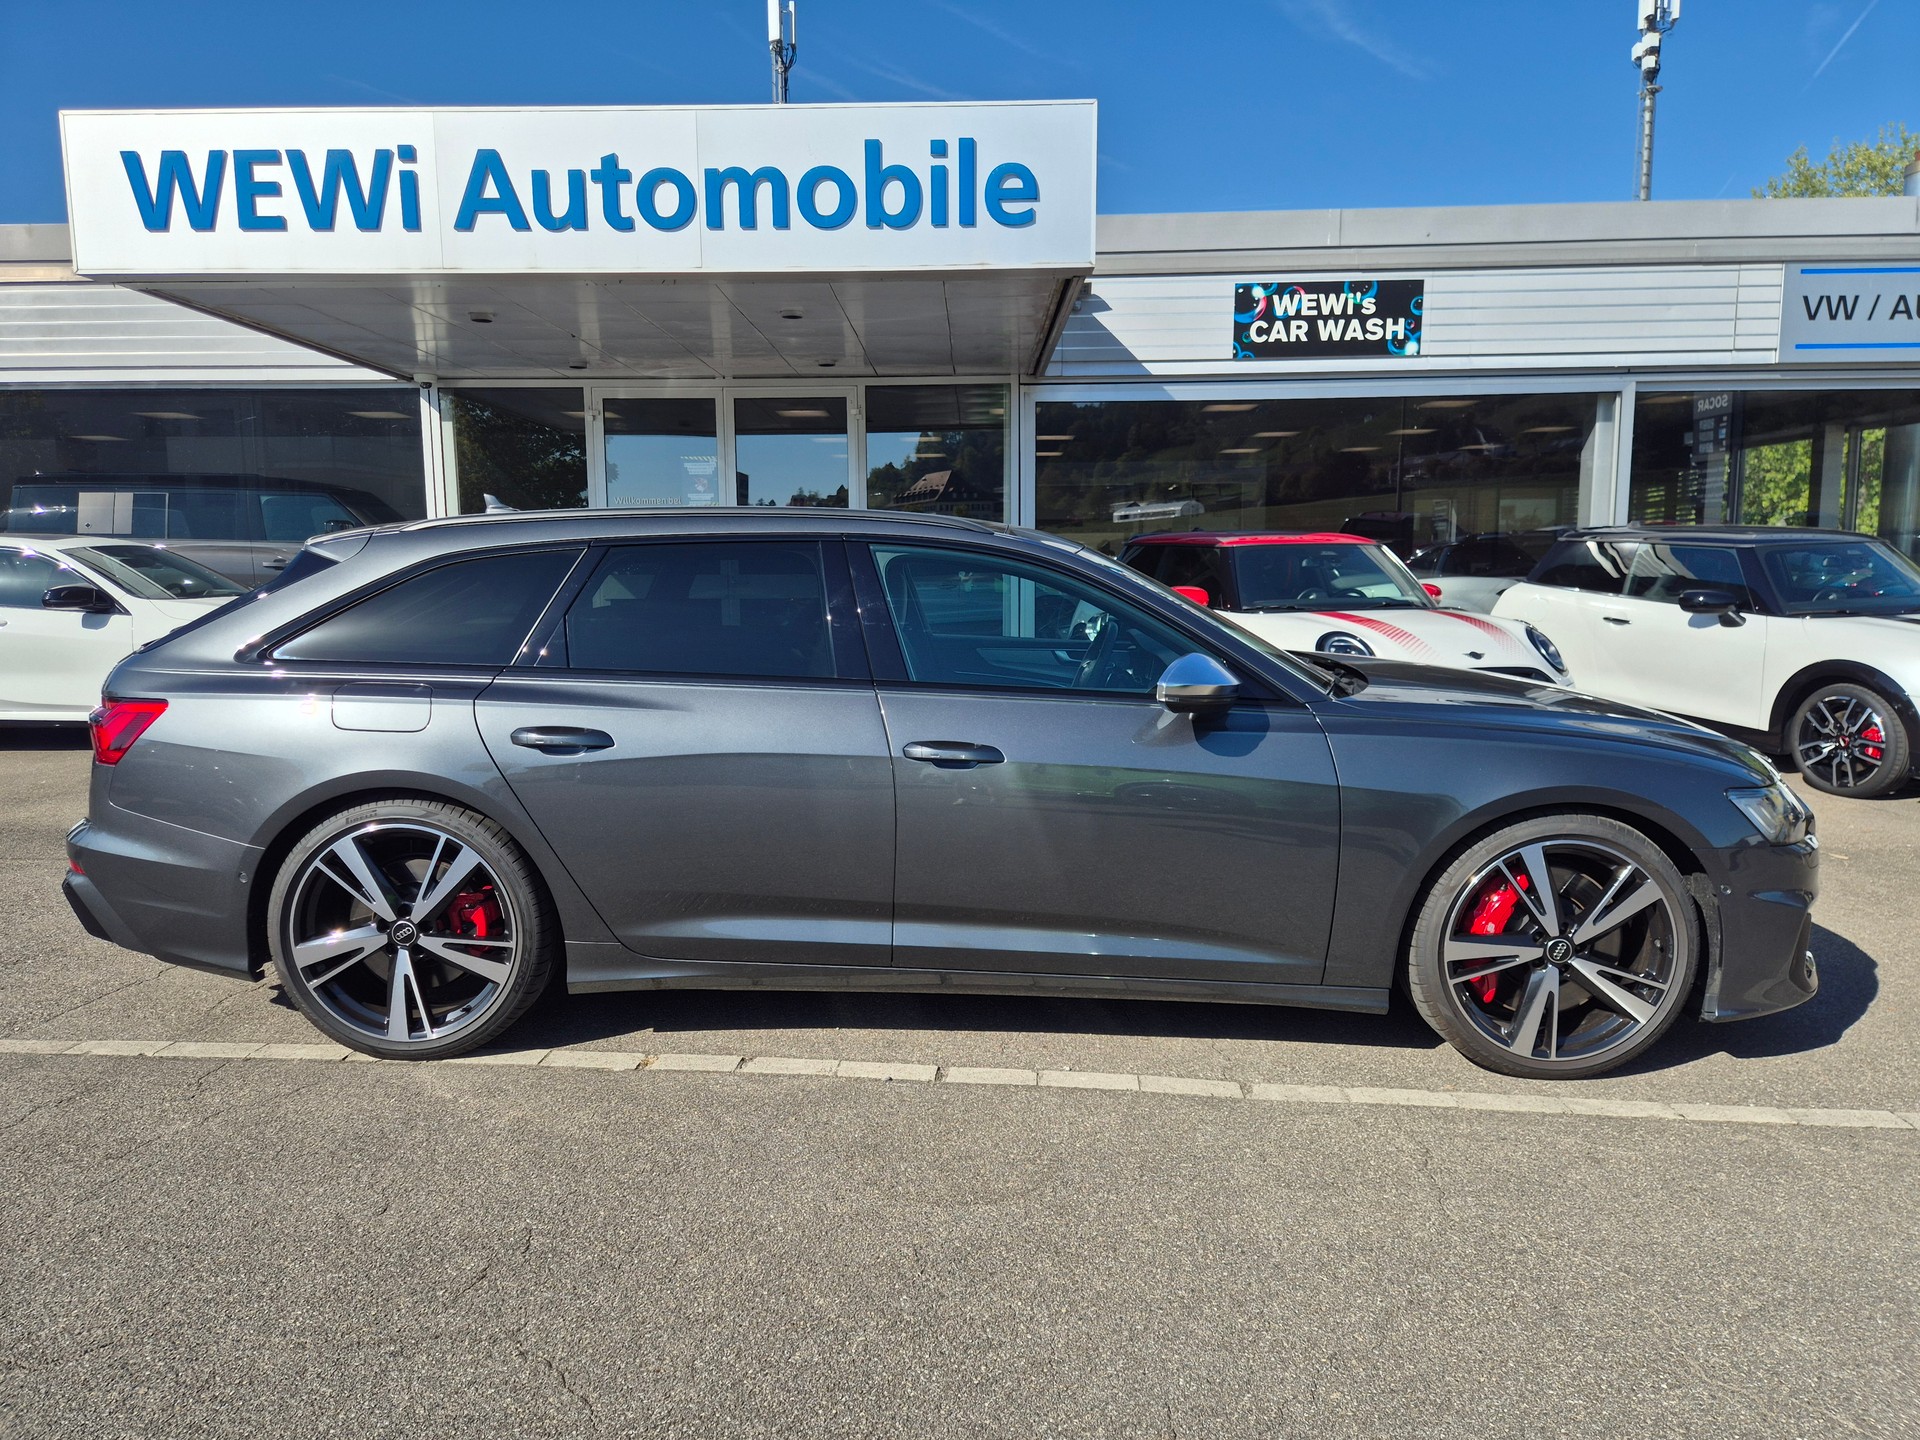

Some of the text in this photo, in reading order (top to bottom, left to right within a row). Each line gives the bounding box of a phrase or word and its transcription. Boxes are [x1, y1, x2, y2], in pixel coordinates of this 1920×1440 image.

[119, 137, 1040, 232] WEWi Automobile
[1272, 291, 1377, 317] WEWi's
[1802, 294, 1920, 321] VW / A
[1250, 317, 1406, 343] CAR WASH
[614, 496, 667, 505] Willkommen
[668, 496, 682, 505] bei
